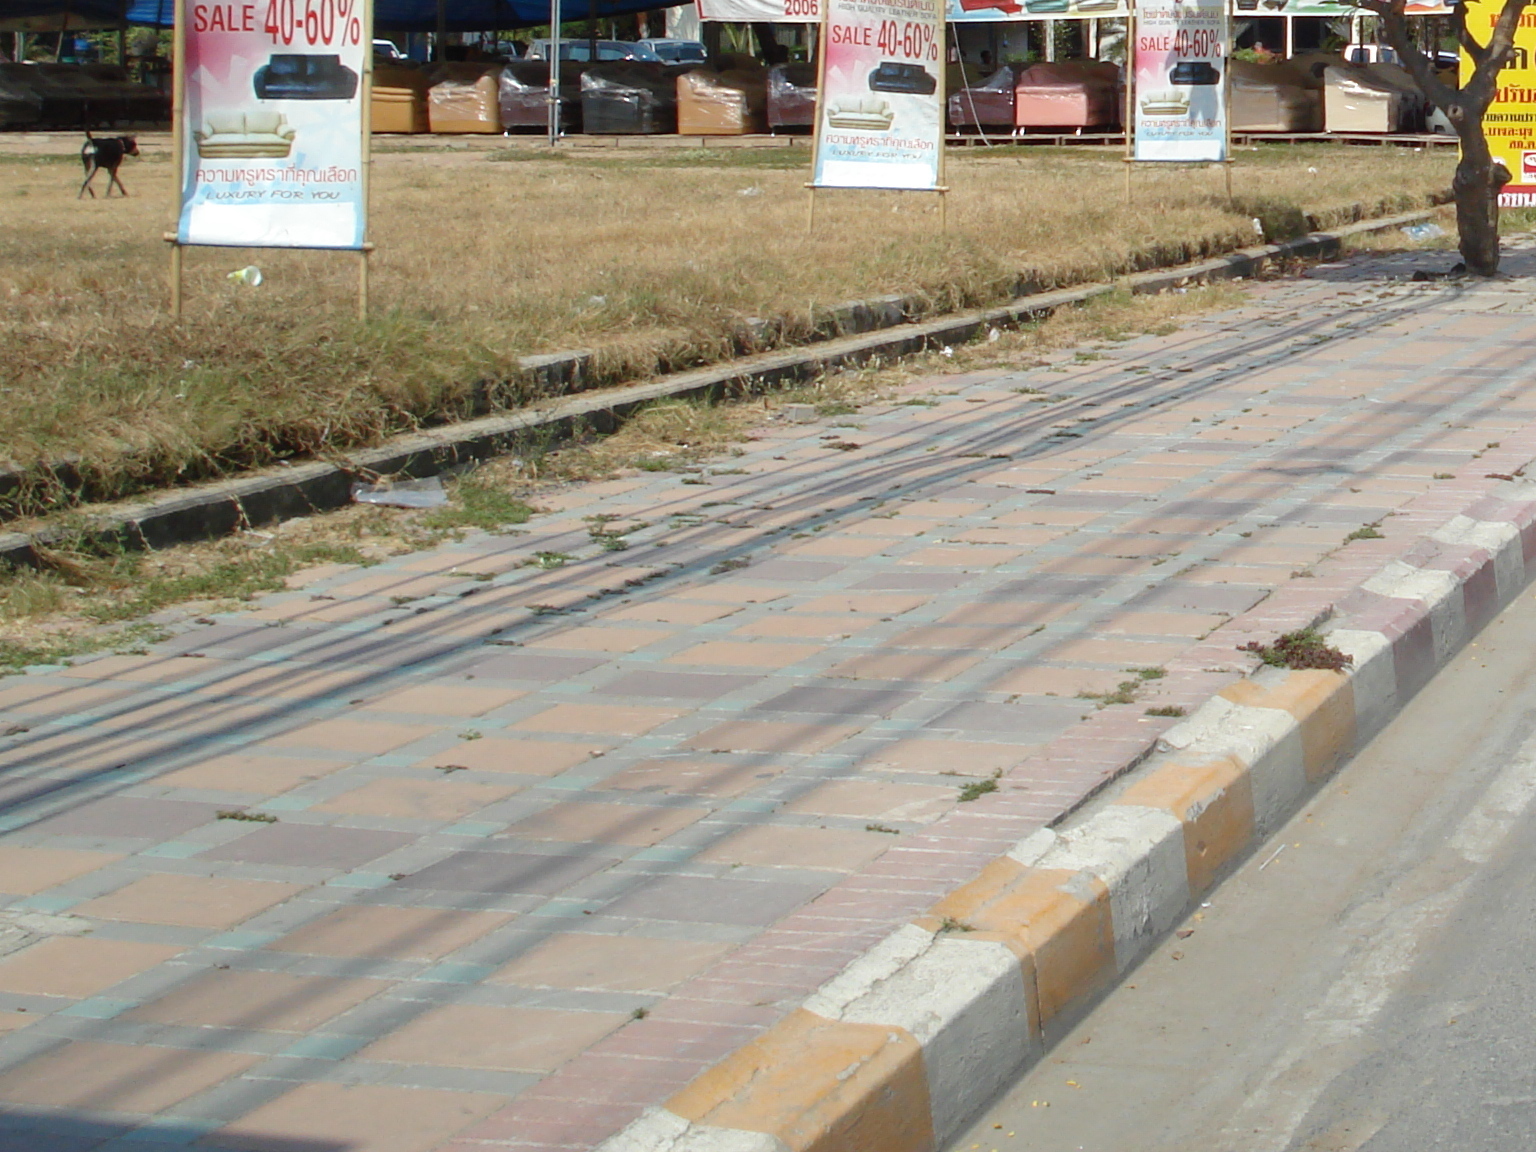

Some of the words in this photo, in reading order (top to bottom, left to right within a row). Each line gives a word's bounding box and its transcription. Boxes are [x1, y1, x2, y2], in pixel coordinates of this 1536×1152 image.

[194, 4, 255, 33] SALE
[832, 24, 873, 47] SALE
[877, 19, 939, 62] 40-60%
[1140, 36, 1169, 51] SALE
[1173, 29, 1221, 58] 40-60%
[270, 189, 304, 200] FOR
[311, 191, 341, 200] YOU
